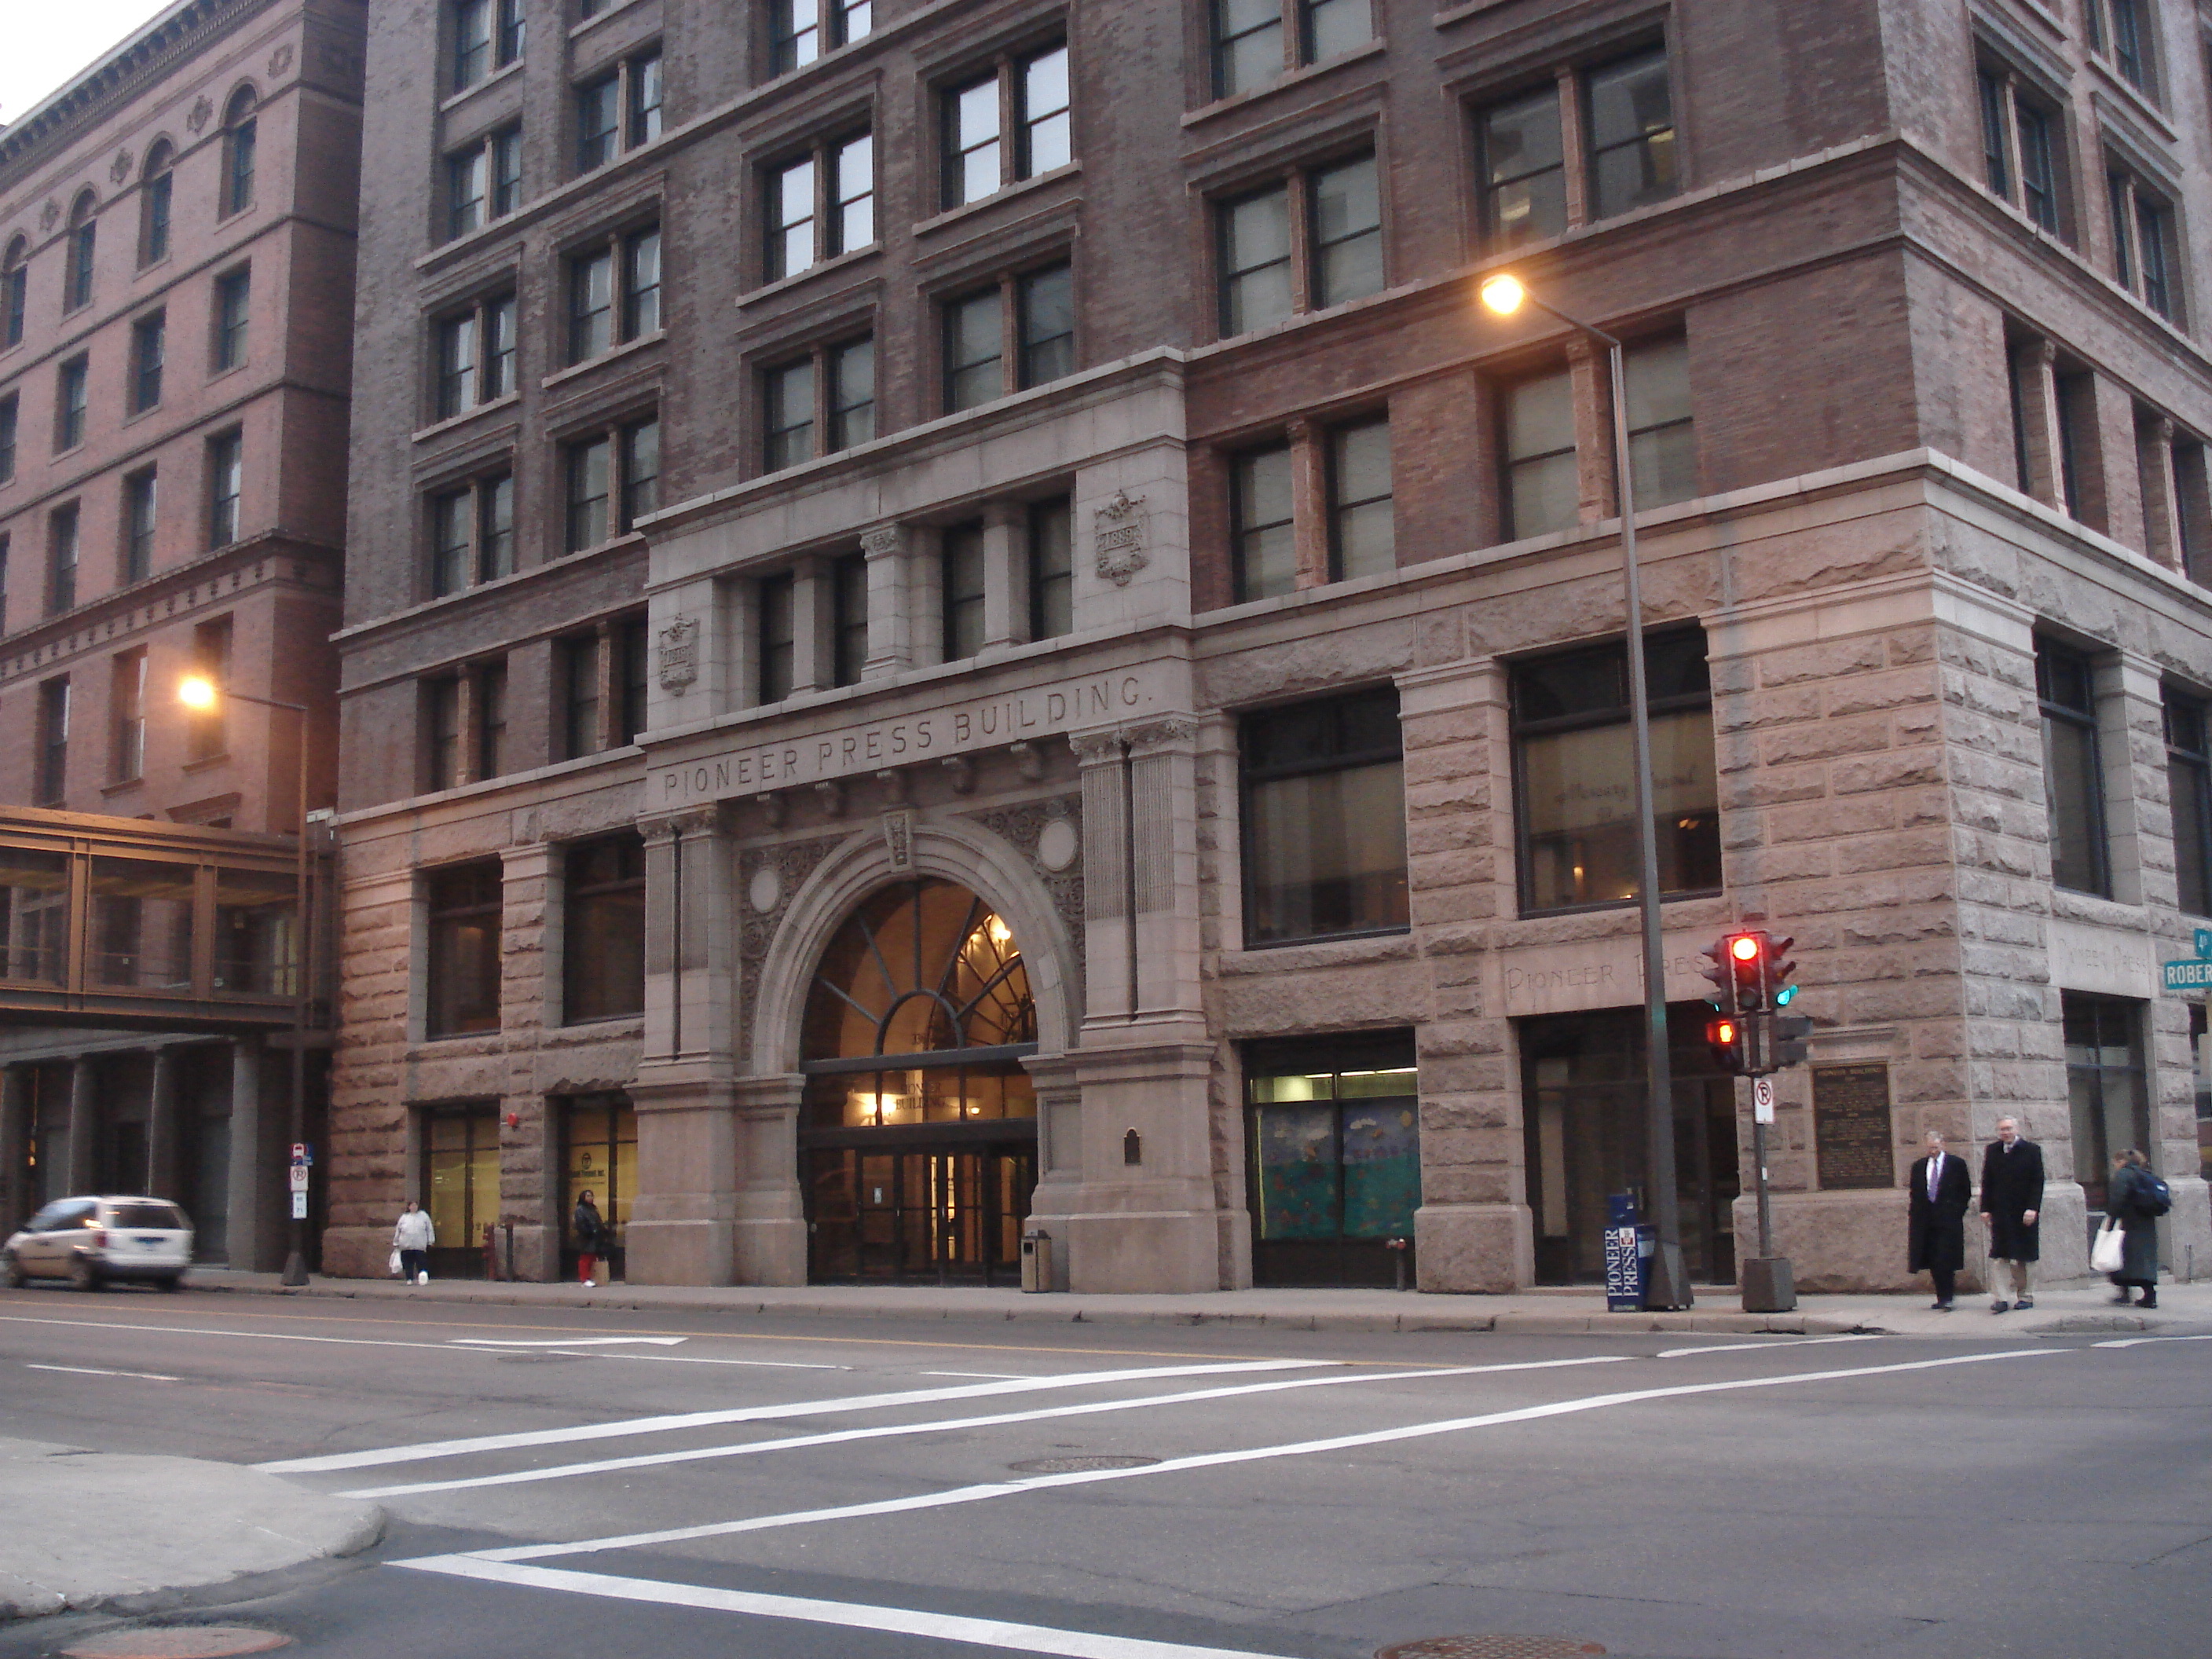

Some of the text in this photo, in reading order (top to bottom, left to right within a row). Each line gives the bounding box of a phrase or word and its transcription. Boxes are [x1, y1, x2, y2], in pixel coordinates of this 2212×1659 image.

[664, 748, 799, 801] PIONEER
[819, 720, 933, 773] PRESS
[1507, 952, 1707, 990] PIONEER PRES
[2166, 964, 2212, 985] ROBER
[1605, 1229, 1623, 1297] PIONEER
[1621, 1247, 1639, 1297] PRESS
